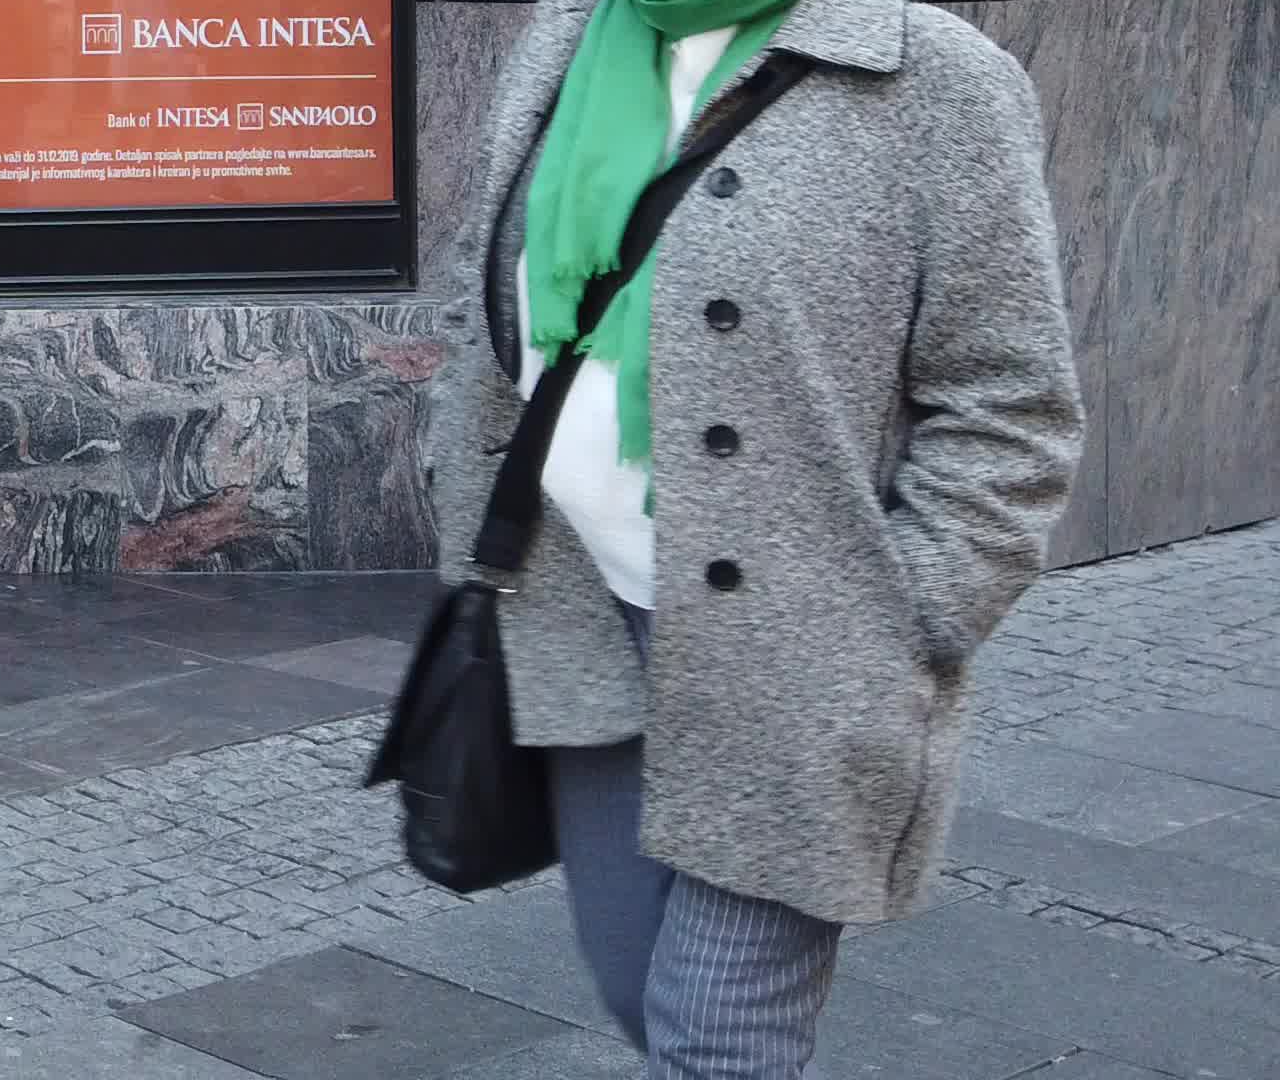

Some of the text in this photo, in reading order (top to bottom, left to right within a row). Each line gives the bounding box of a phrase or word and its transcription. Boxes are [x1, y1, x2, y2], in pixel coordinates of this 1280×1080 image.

[132, 16, 375, 49] BANCA INTESA
[108, 105, 377, 129] Bank of INTESA SANPAOLO
[23, 150, 36, 162] do
[274, 150, 286, 159] na
